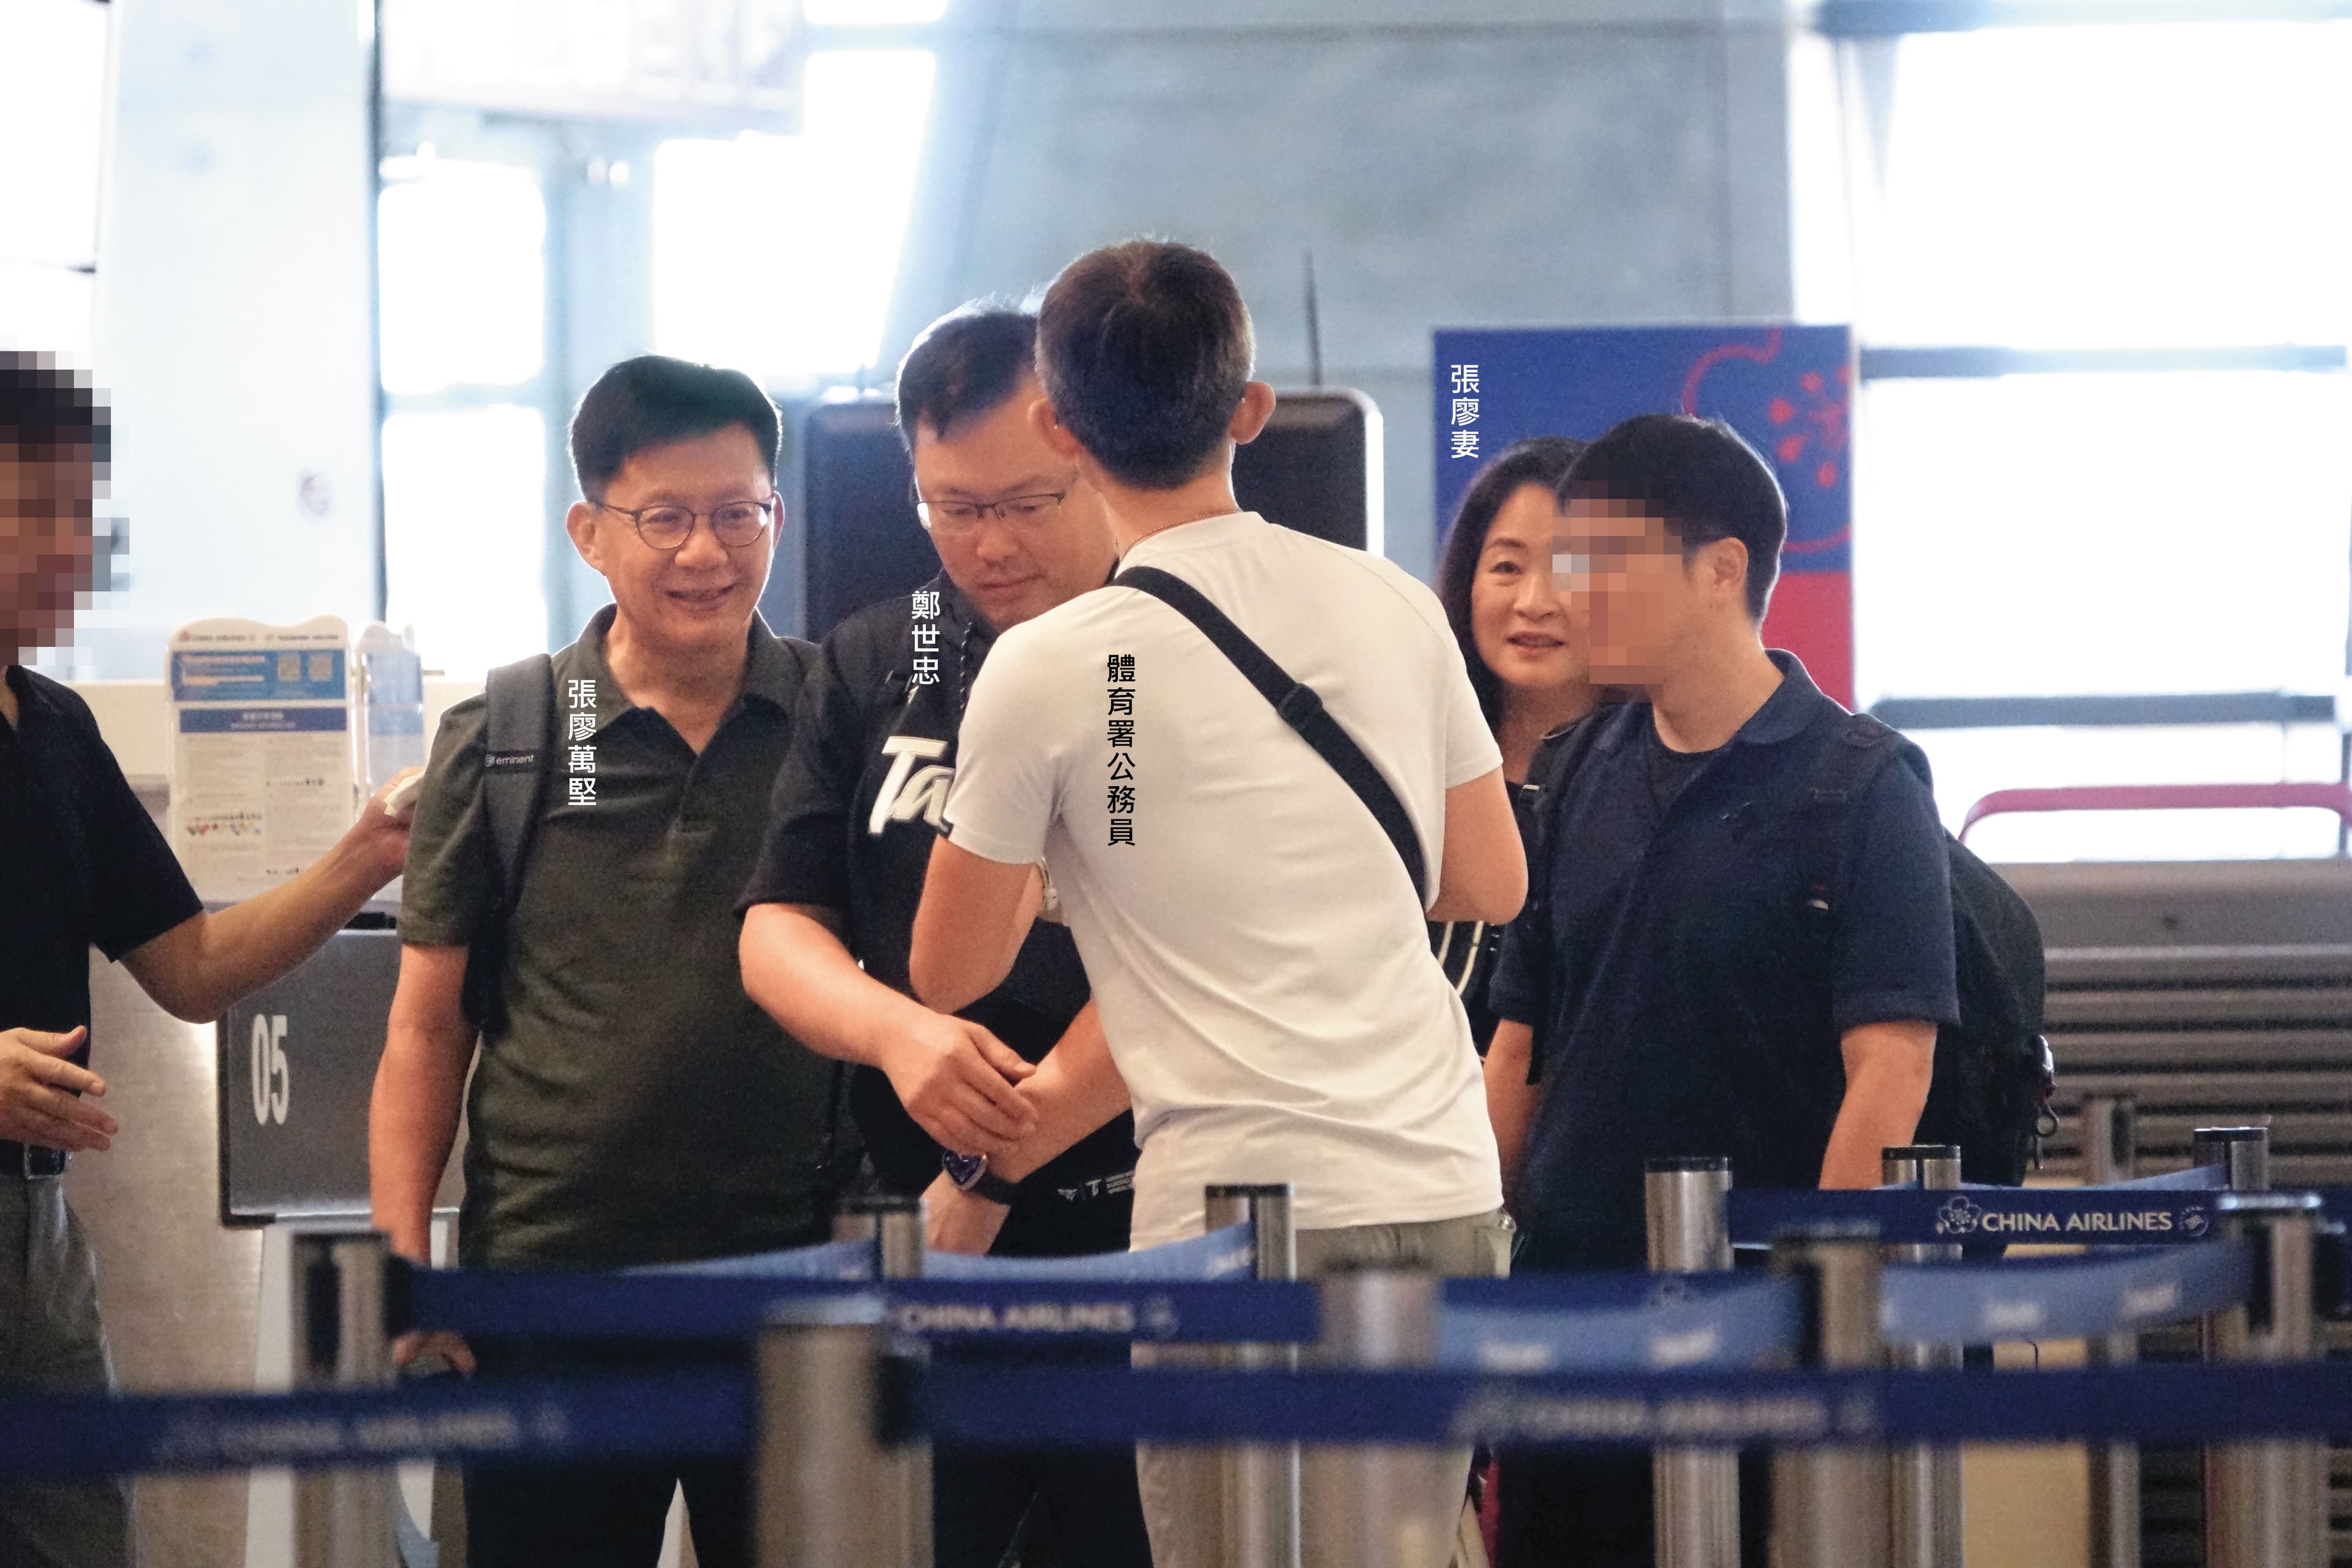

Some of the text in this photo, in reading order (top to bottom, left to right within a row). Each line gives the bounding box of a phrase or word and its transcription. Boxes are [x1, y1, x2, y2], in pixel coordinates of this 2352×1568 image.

[496, 753, 534, 765] eminent
[251, 1014, 290, 1125] 05
[1981, 1212, 2173, 1232] CHINA AIRLINES
